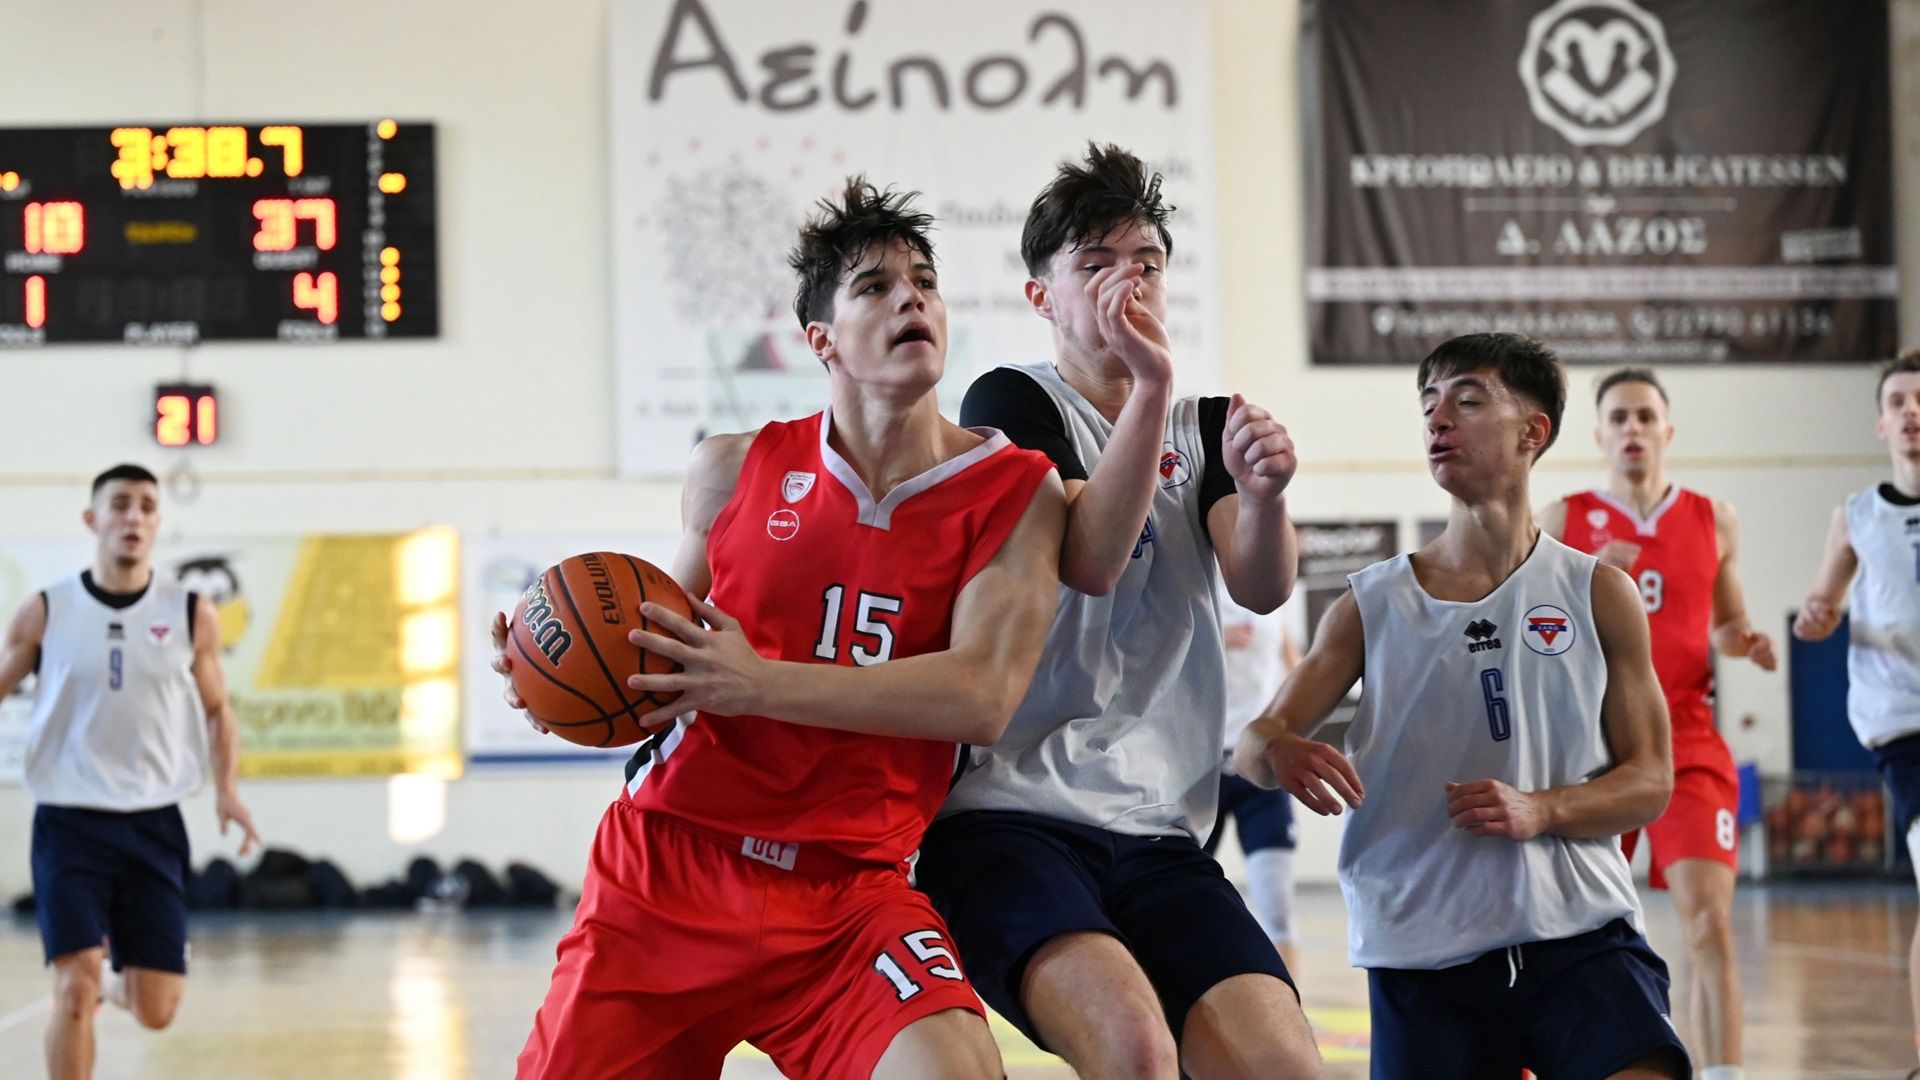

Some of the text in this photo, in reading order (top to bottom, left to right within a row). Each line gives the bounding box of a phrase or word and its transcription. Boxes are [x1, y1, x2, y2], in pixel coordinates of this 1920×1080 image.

[1577, 154, 1600, 186] &
[1607, 153, 1848, 188] DELICATESSEN
[253, 198, 336, 251] 37
[294, 272, 337, 324] 4
[157, 396, 216, 446] 21
[769, 519, 797, 528] GSA
[1639, 569, 1663, 613] 8
[813, 584, 903, 667] 15
[109, 648, 122, 690] 9
[1480, 667, 1511, 741] 6
[1715, 808, 1735, 851] 8
[872, 929, 965, 1002] 15
